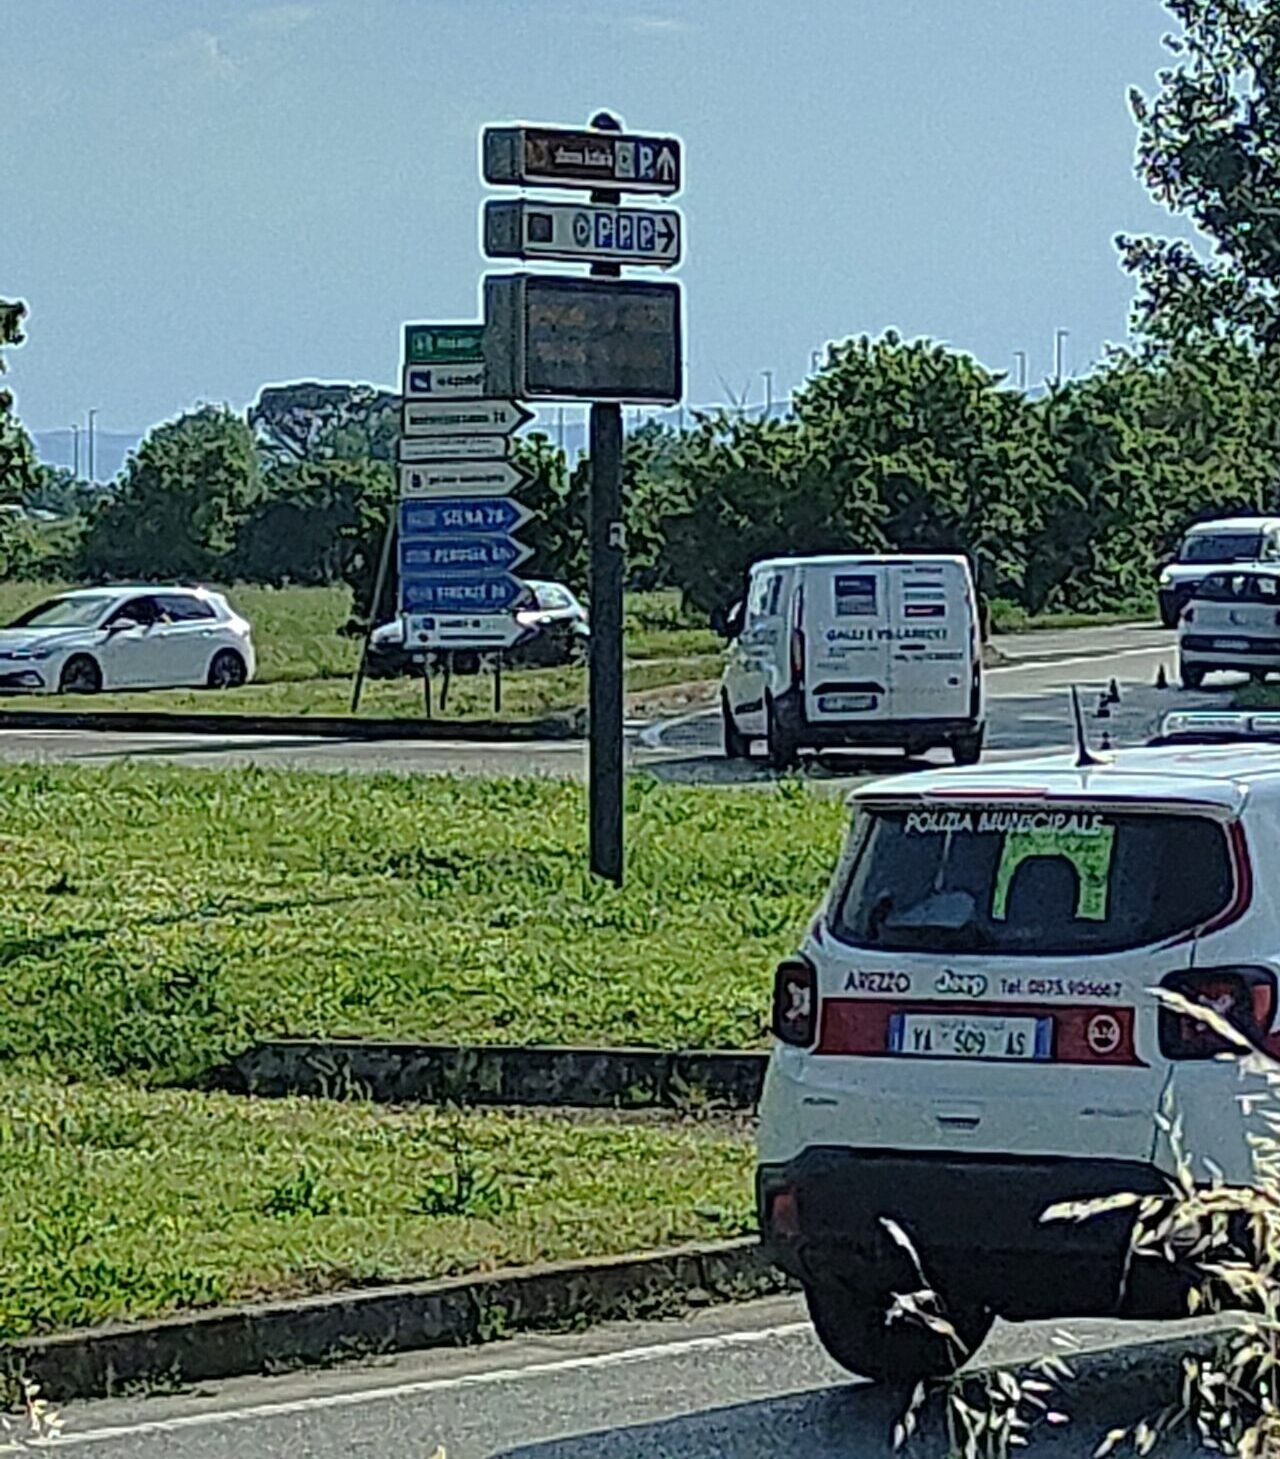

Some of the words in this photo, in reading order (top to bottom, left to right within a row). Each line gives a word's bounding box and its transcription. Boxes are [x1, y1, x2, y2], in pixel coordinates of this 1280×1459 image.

[904, 812, 973, 834] POLIZIA
[977, 812, 1104, 837] MUNICIPALE
[844, 971, 911, 993] AREZZO
[935, 969, 988, 998] Jeep
[913, 1027, 933, 1051] YA
[954, 1029, 986, 1055] 509
